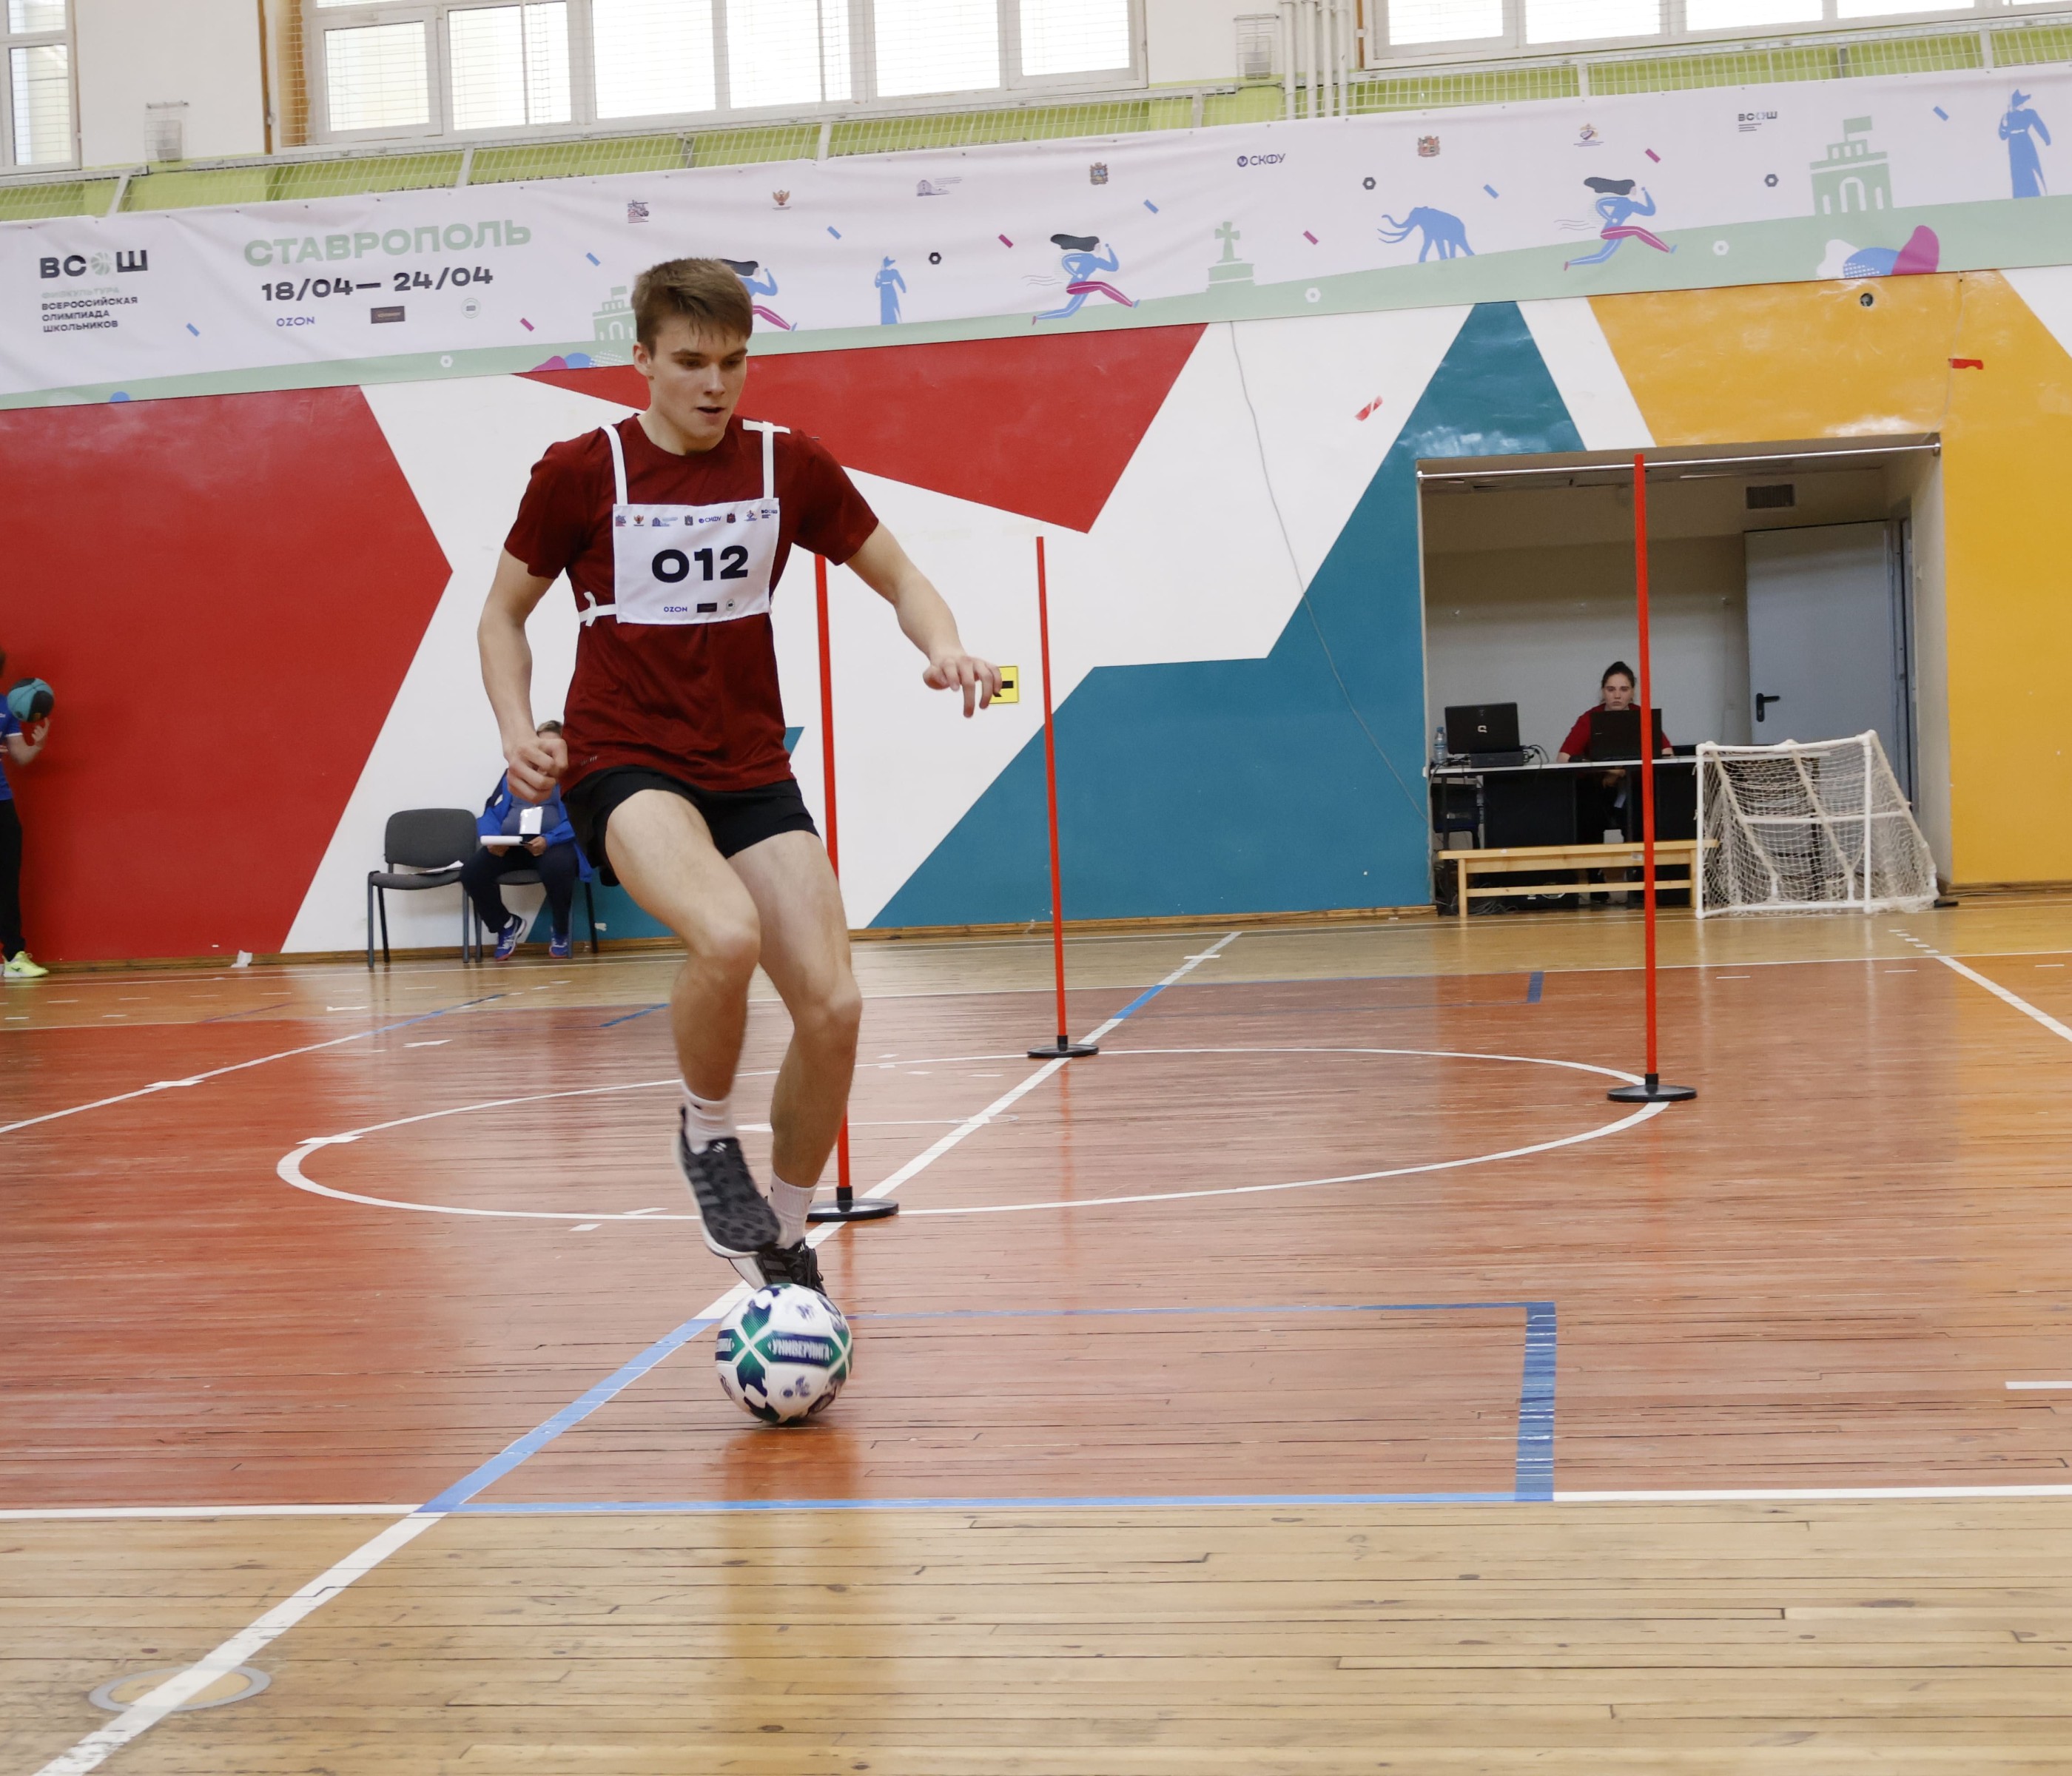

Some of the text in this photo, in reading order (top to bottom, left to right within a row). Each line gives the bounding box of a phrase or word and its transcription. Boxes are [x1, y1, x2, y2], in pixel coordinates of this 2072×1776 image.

[1249, 153, 1286, 166] СКФУ
[244, 220, 531, 266] СТАВРОПОЛЬ
[393, 266, 494, 292] 24/04
[41, 297, 138, 310] ВСЕРОССИЙСКАЯ
[41, 310, 110, 321] ОЛИМПИАДА
[276, 316, 315, 327] OZON
[43, 320, 118, 332] ШКОЛЬНИКОВ
[652, 545, 748, 583] 012
